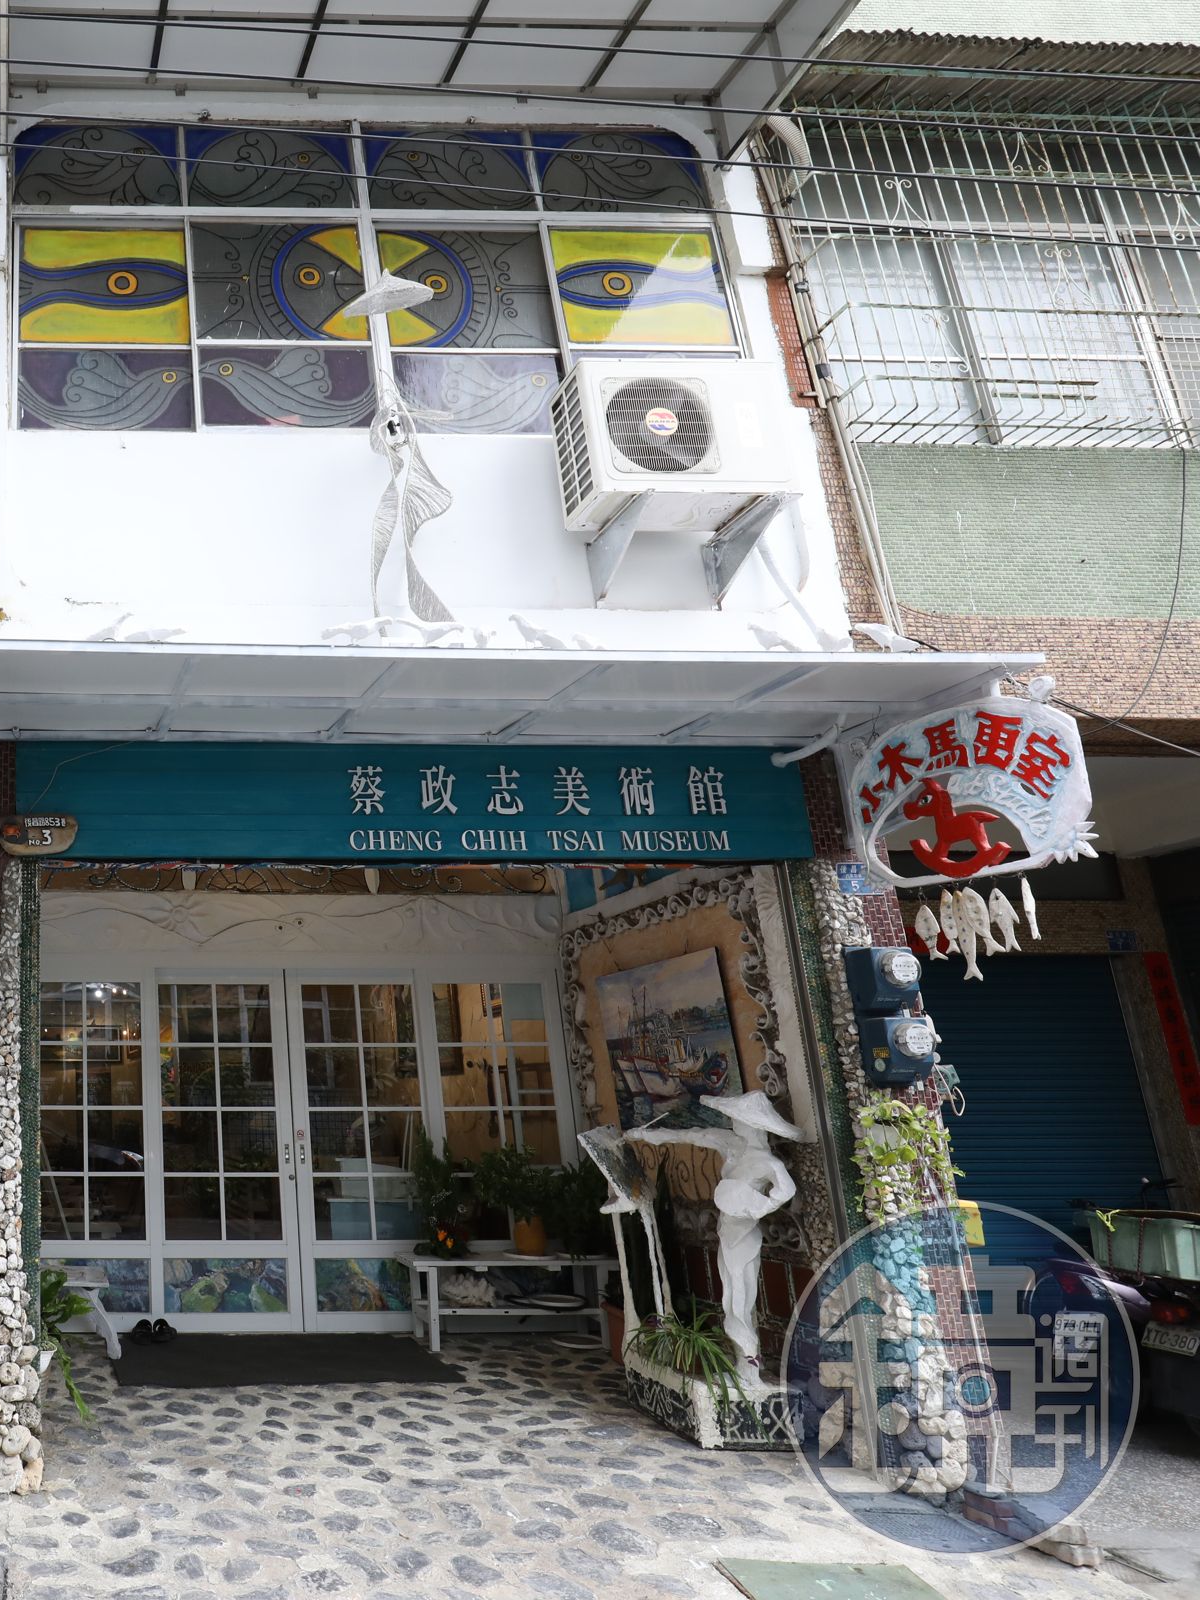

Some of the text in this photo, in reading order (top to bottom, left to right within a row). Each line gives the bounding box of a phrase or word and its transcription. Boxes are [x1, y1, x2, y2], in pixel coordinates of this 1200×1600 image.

[347, 765, 729, 816] 蔡政志美術館
[349, 829, 731, 852] CHENG CHIH TSAI MUSEUM
[851, 880, 860, 892] 5
[1144, 1326, 1197, 1352] XTC-380
